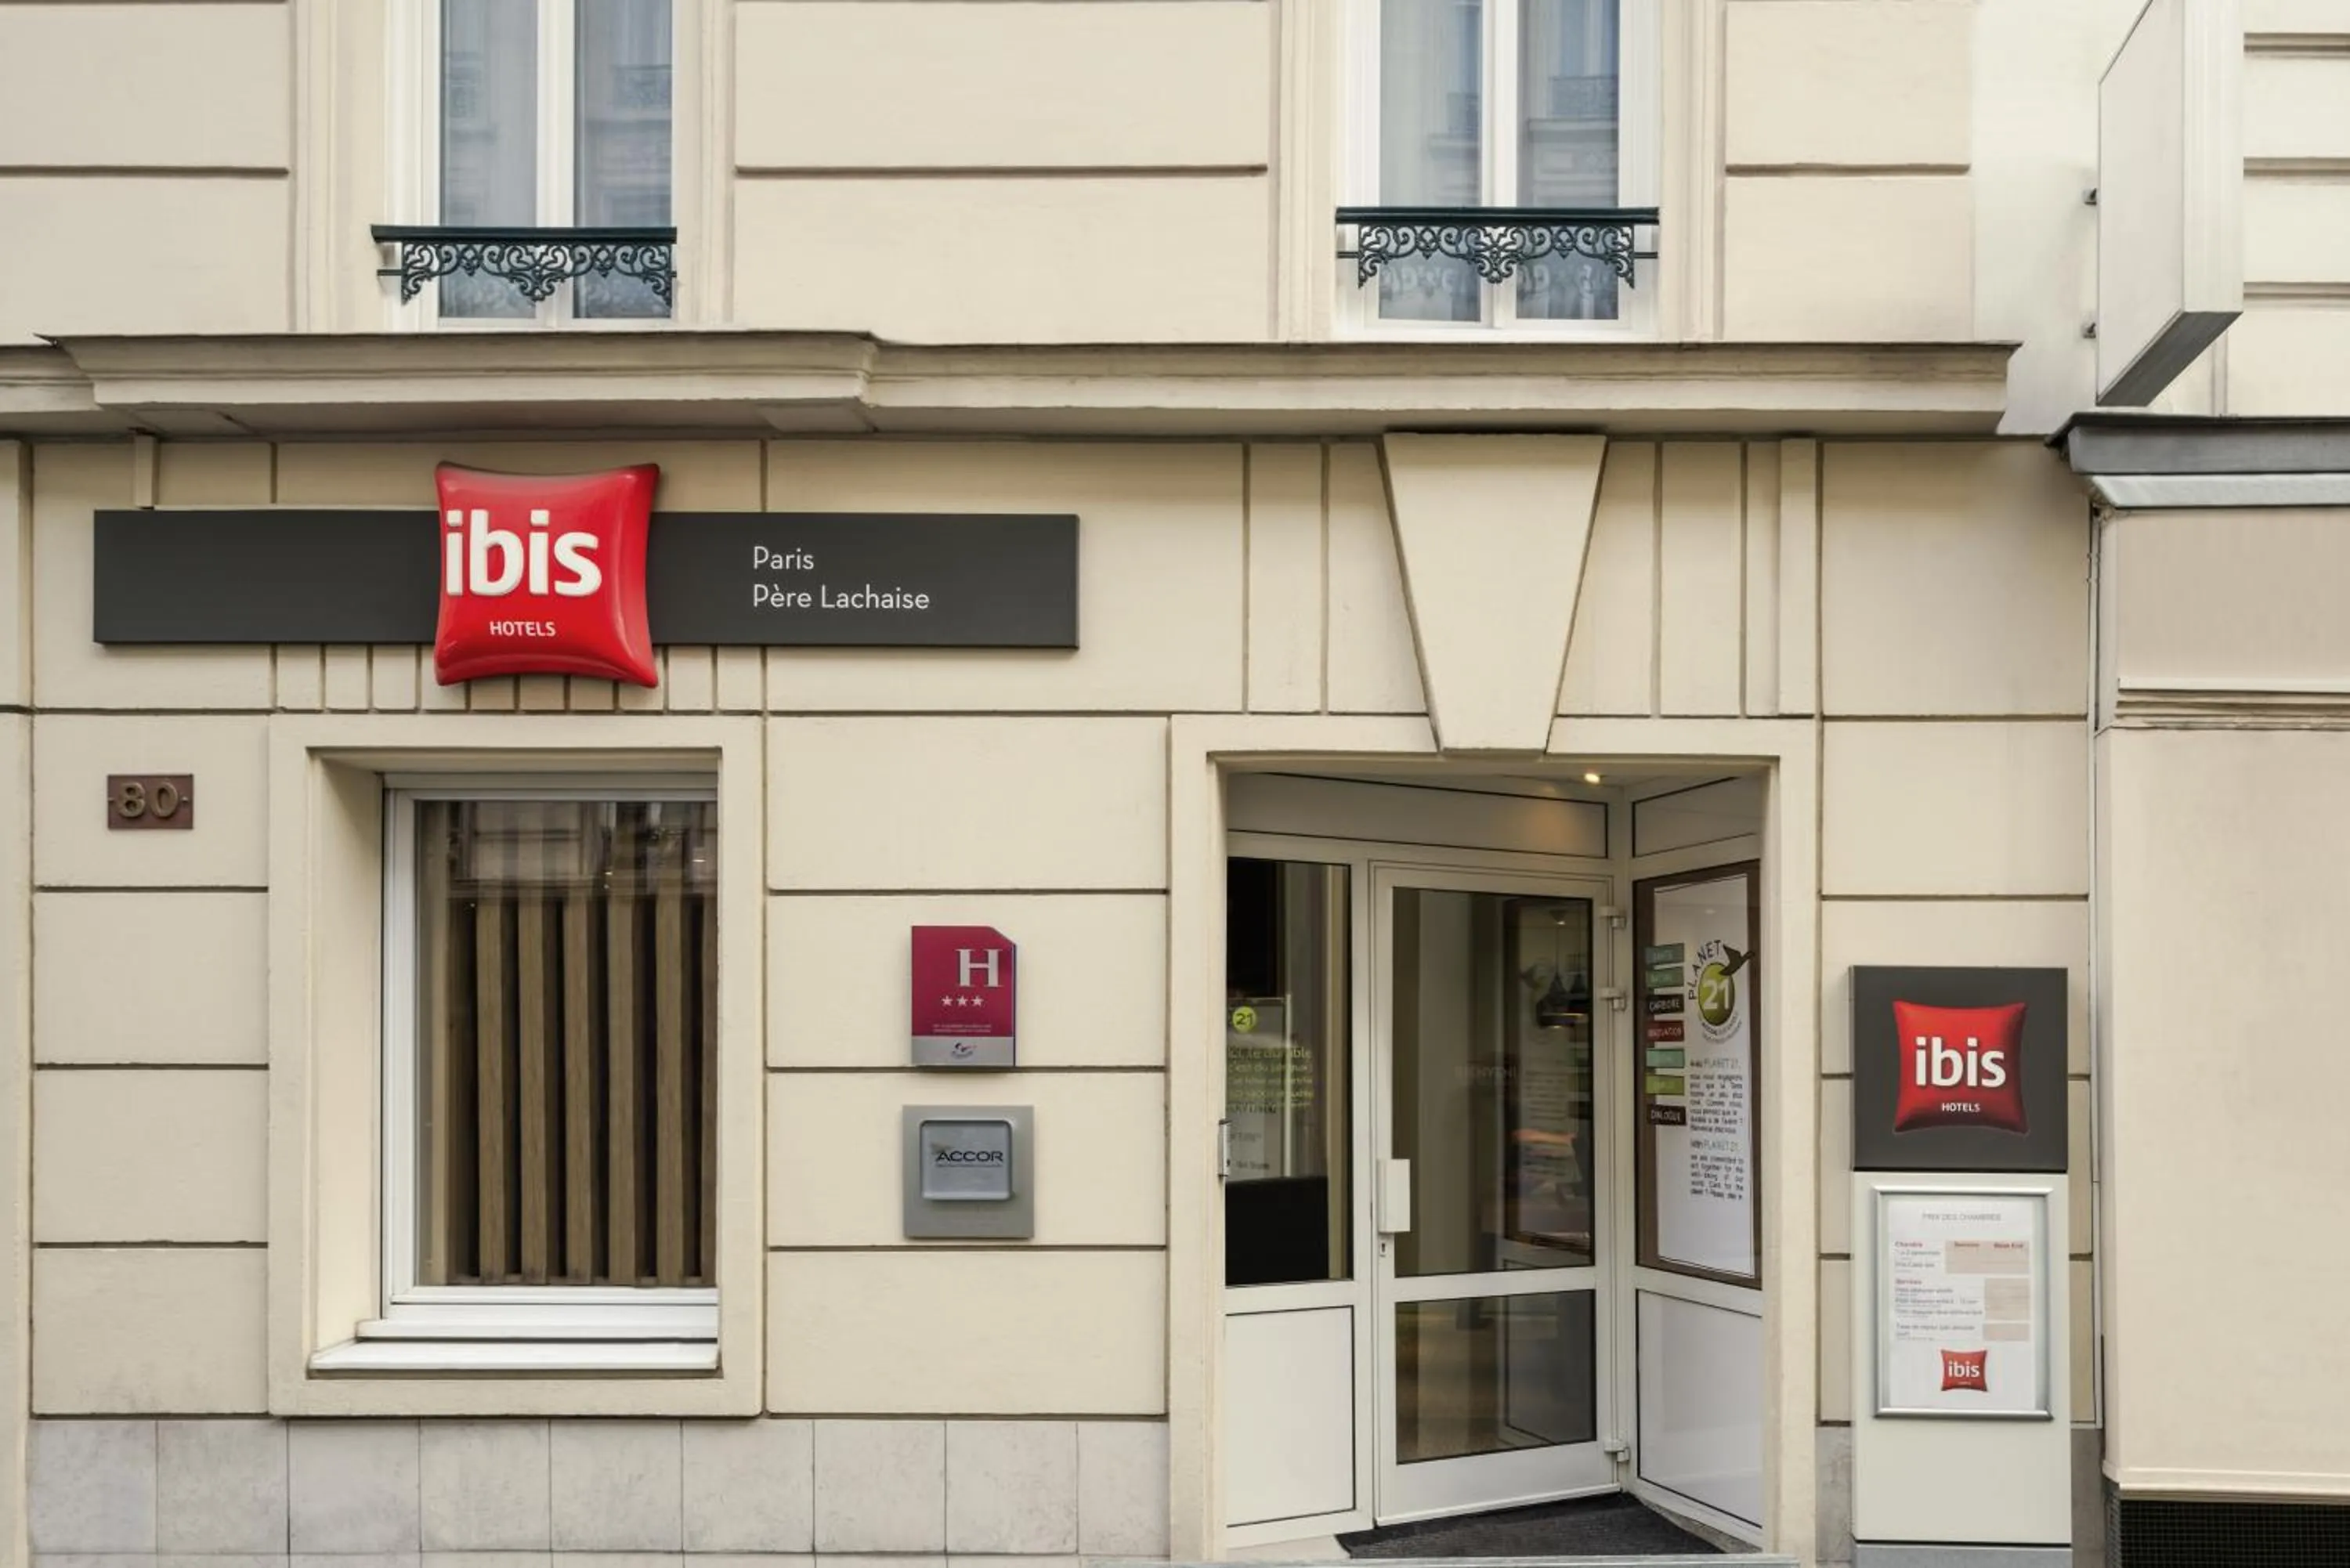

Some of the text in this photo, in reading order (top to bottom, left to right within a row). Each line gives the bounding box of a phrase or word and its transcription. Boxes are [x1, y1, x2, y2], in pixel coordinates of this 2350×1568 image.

[445, 509, 602, 598] ibis
[753, 547, 815, 570] Paris
[753, 583, 930, 610] Père Lachaise
[489, 621, 556, 637] HOTELS
[118, 782, 179, 818] 80
[955, 948, 1004, 988] H
[1688, 939, 1722, 1000] PLANET
[1703, 980, 1730, 1010] 21
[1235, 1013, 1253, 1025] 21
[1915, 1036, 2006, 1088] ibis
[1942, 1102, 1980, 1113] HOTELS
[935, 1151, 1003, 1162] ACCOR
[1948, 1360, 1980, 1378] ibis
